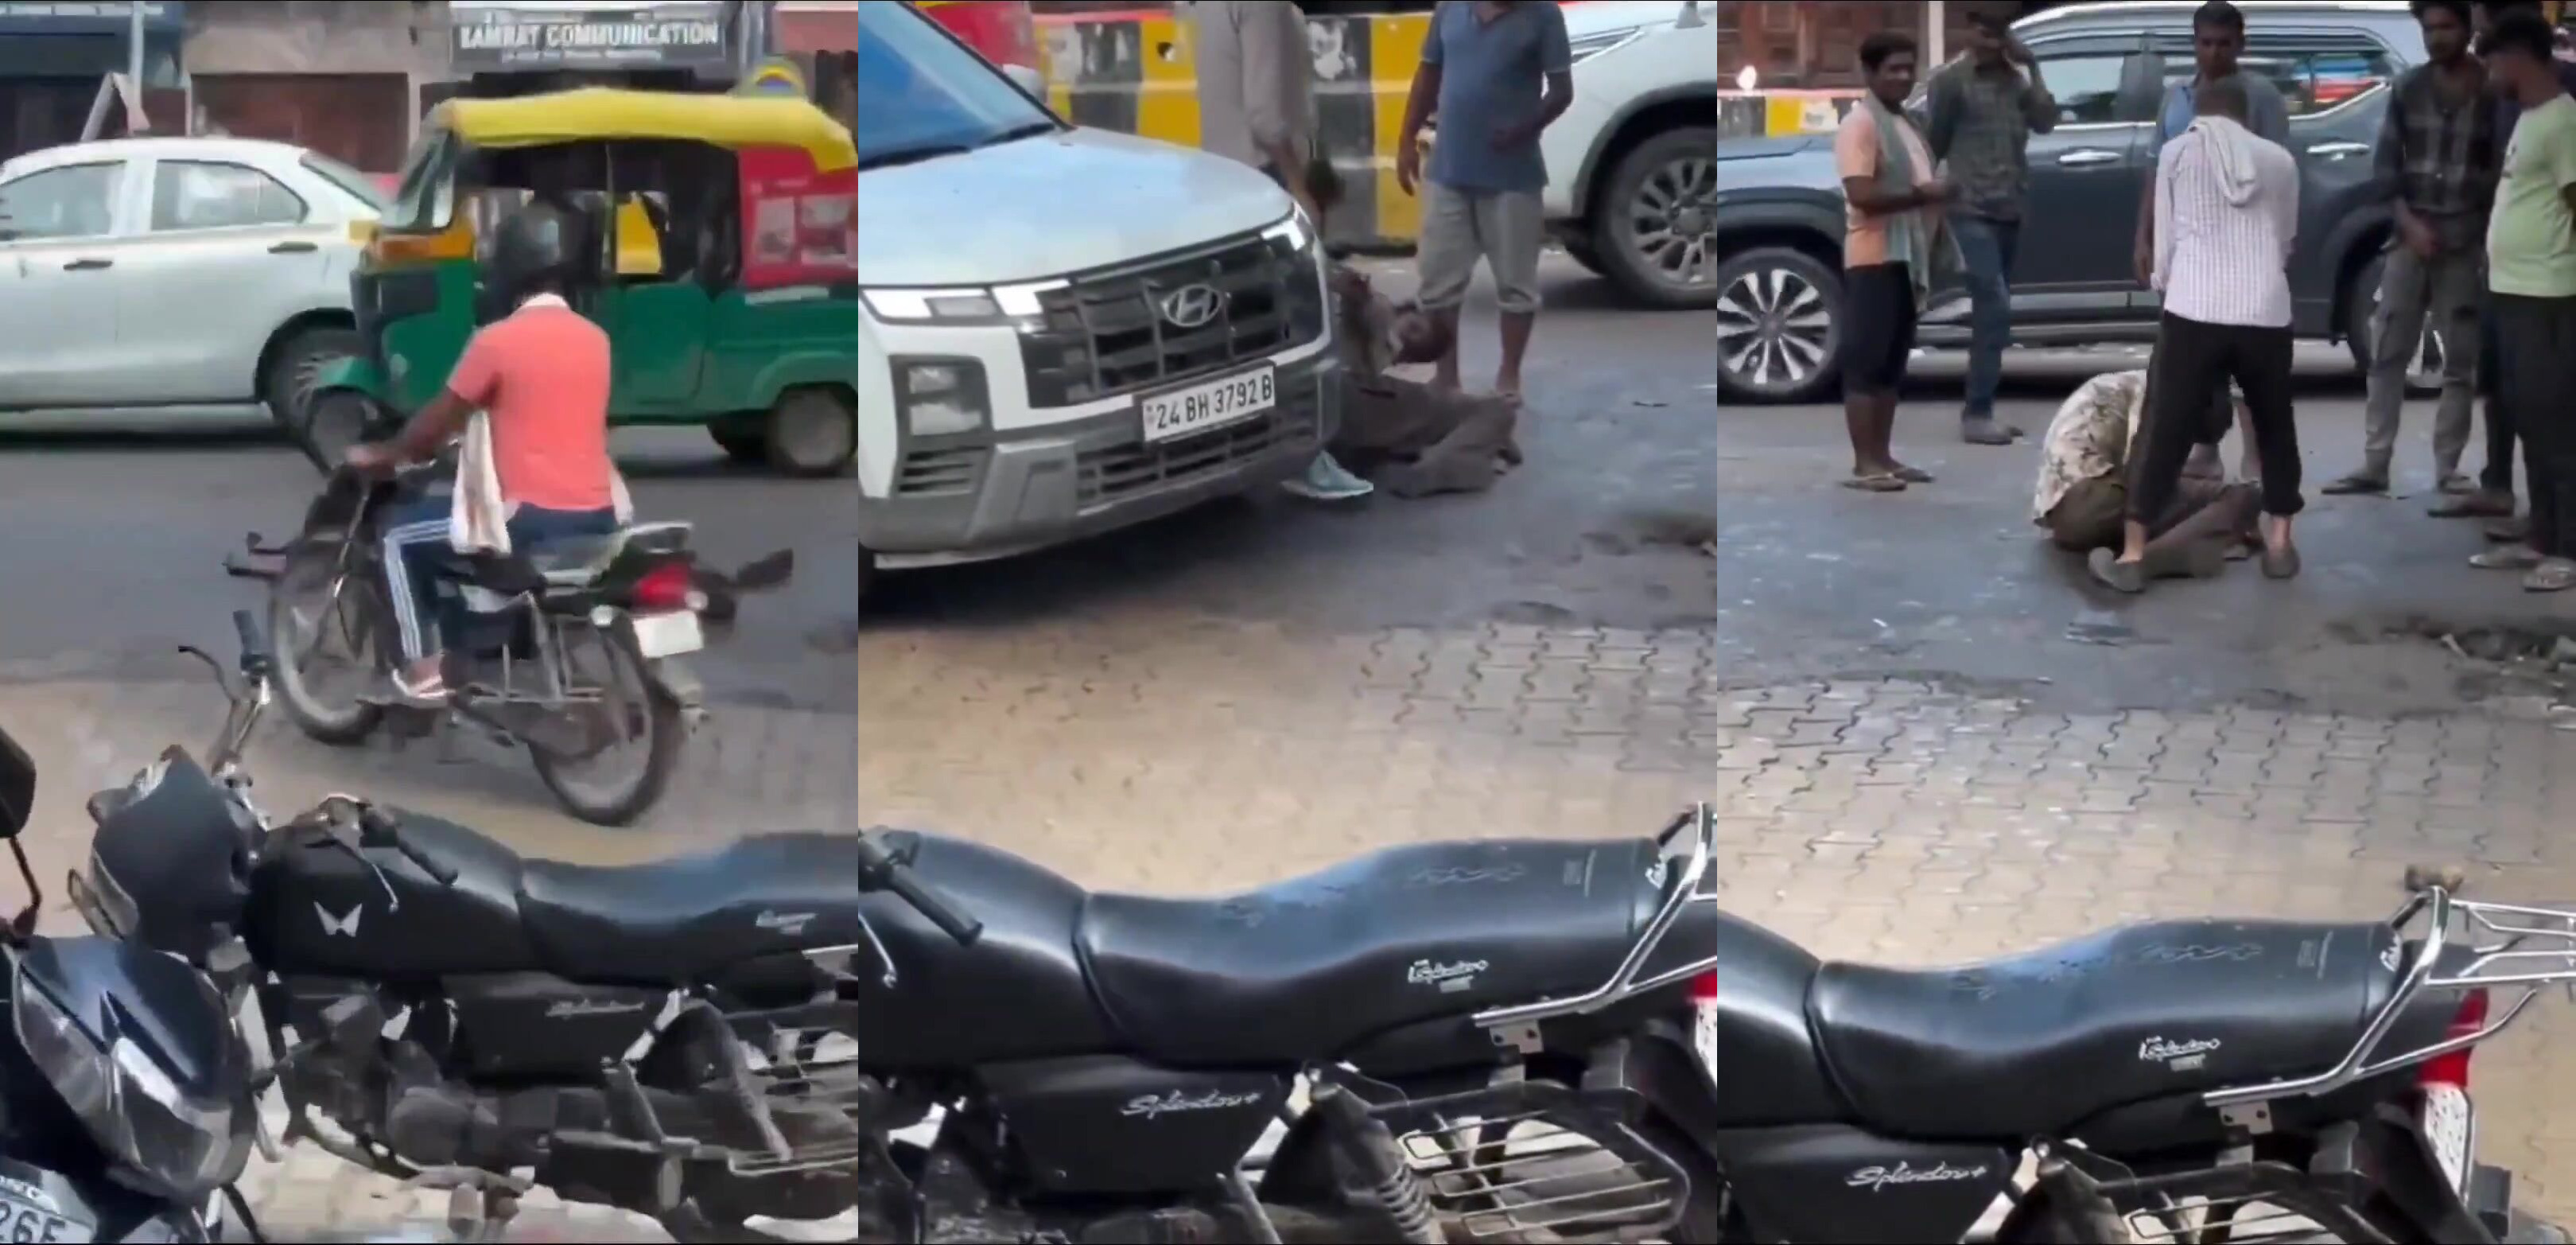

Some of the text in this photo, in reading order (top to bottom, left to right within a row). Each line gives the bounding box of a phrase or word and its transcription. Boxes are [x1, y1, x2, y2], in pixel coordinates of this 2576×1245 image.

[1156, 400, 1181, 430] 24
[1184, 393, 1210, 422] BH
[1214, 378, 1257, 414] 3792
[1261, 374, 1272, 402] B
